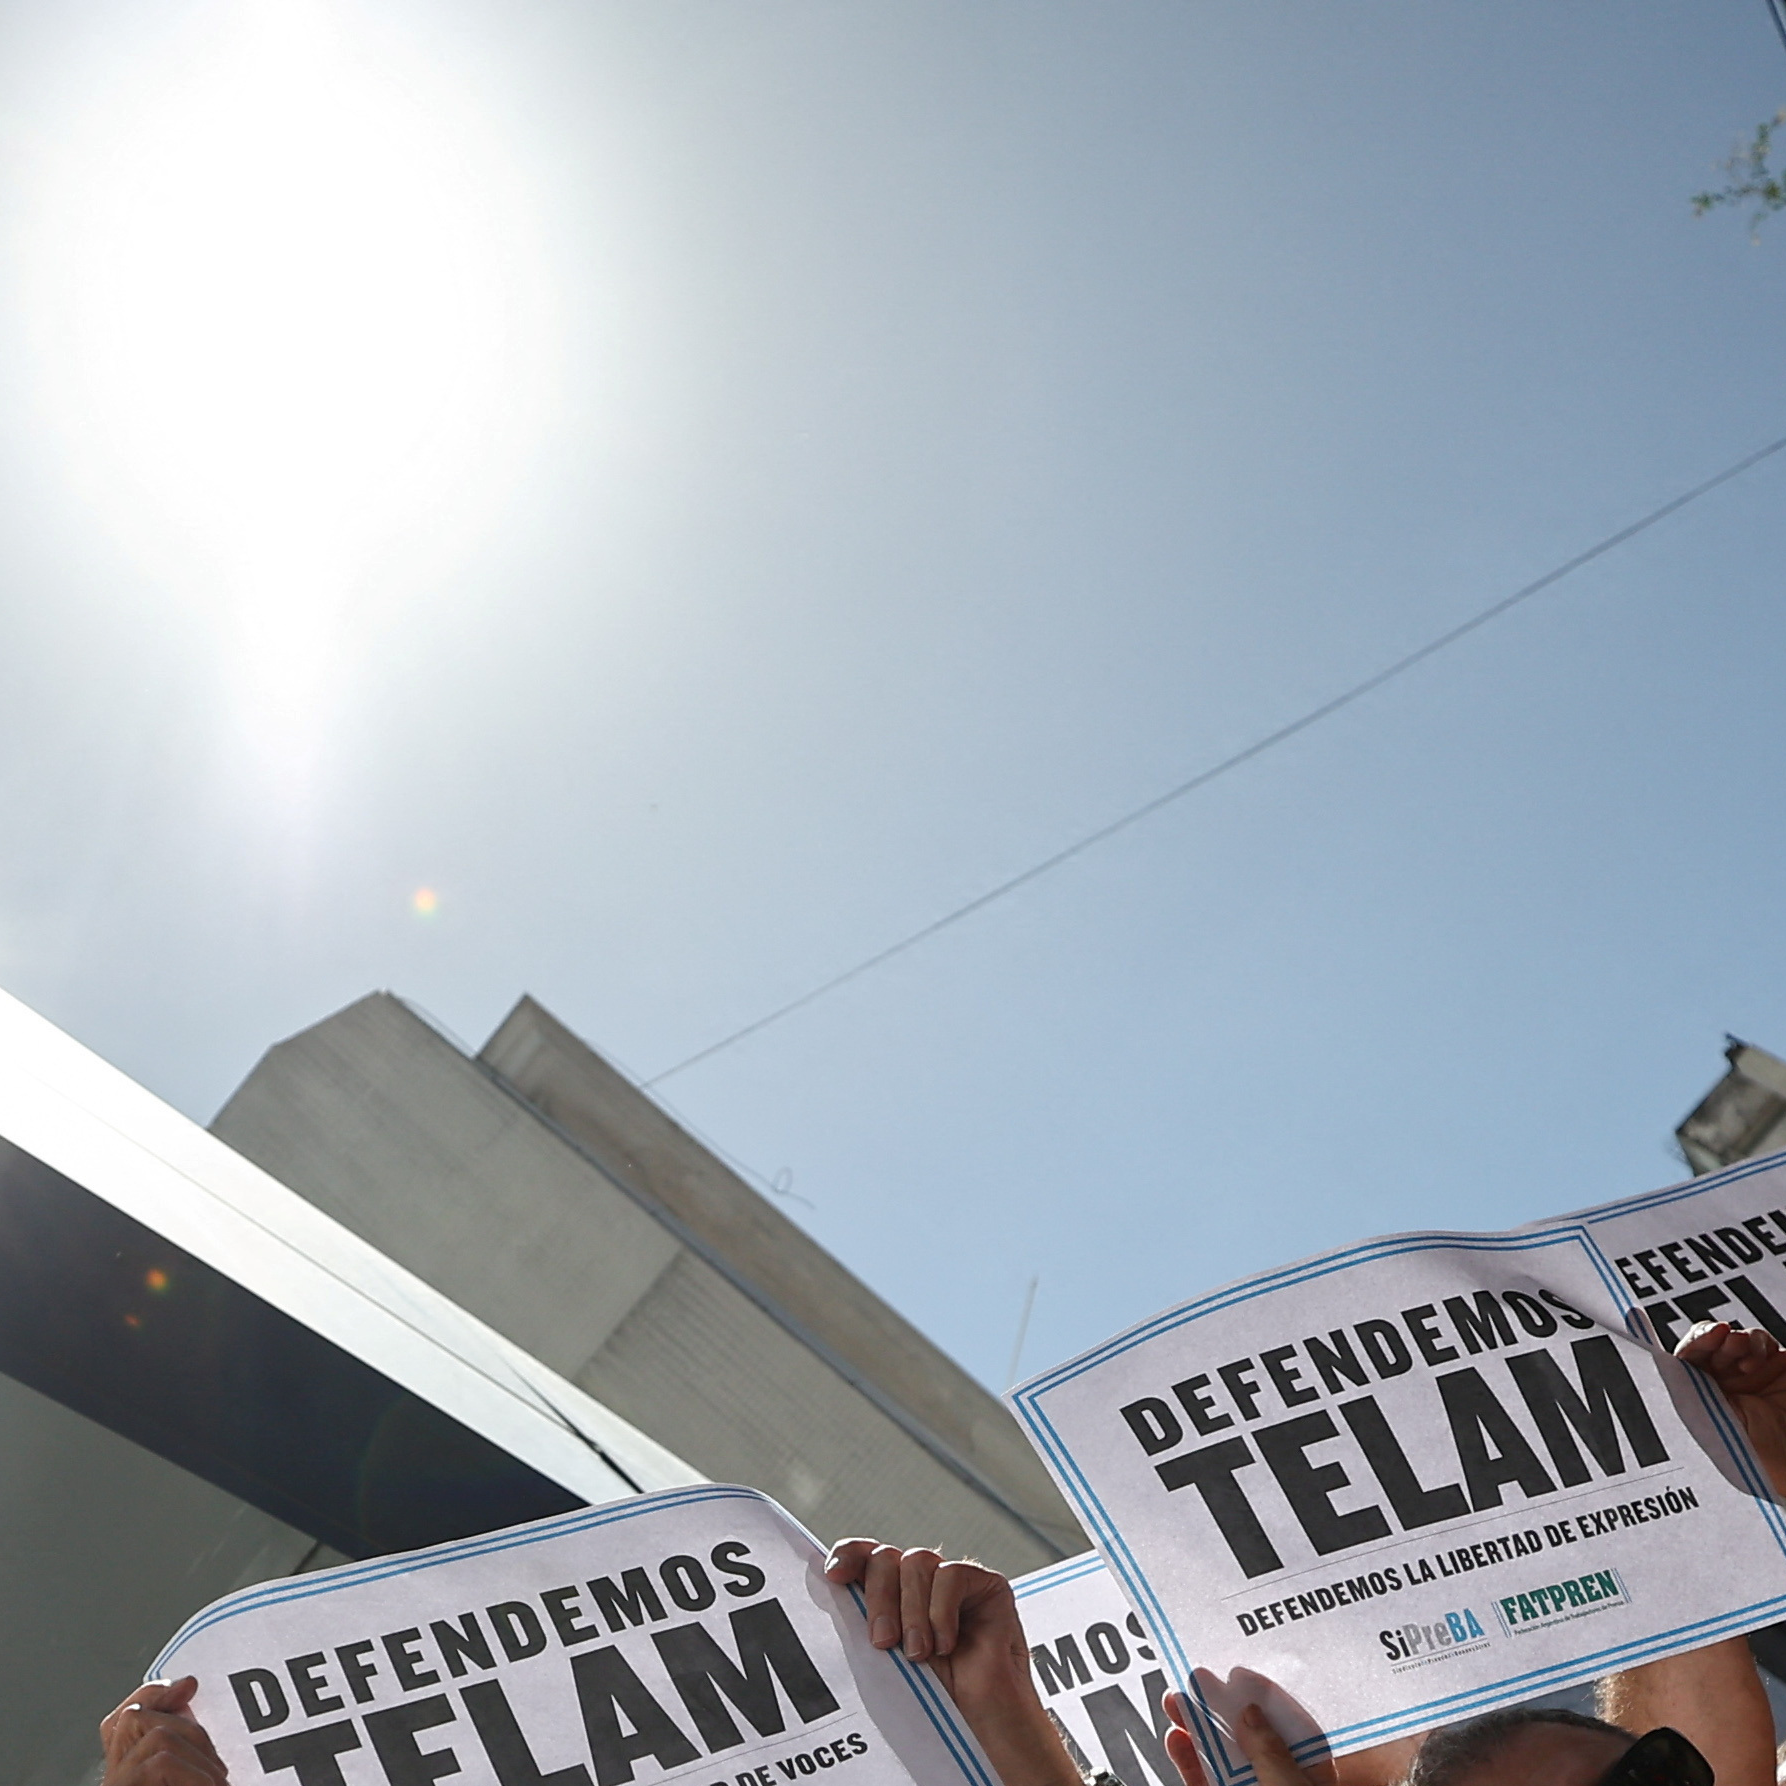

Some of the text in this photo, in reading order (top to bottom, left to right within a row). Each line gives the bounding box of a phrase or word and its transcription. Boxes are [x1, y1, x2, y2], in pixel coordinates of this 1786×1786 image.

[1120, 1289, 1595, 1455] DEFENDEMOS
[1155, 1334, 1670, 1580] TELAM
[229, 1542, 765, 1732] DEFENDEMOS
[1236, 1486, 1700, 1637] DEFENDEMOS LA LIBERTAD DE EXPRESIÓN
[1379, 1608, 1485, 1661] SiPreBA
[1500, 1570, 1619, 1625] FATPREN
[777, 1733, 869, 1780] VOCES
